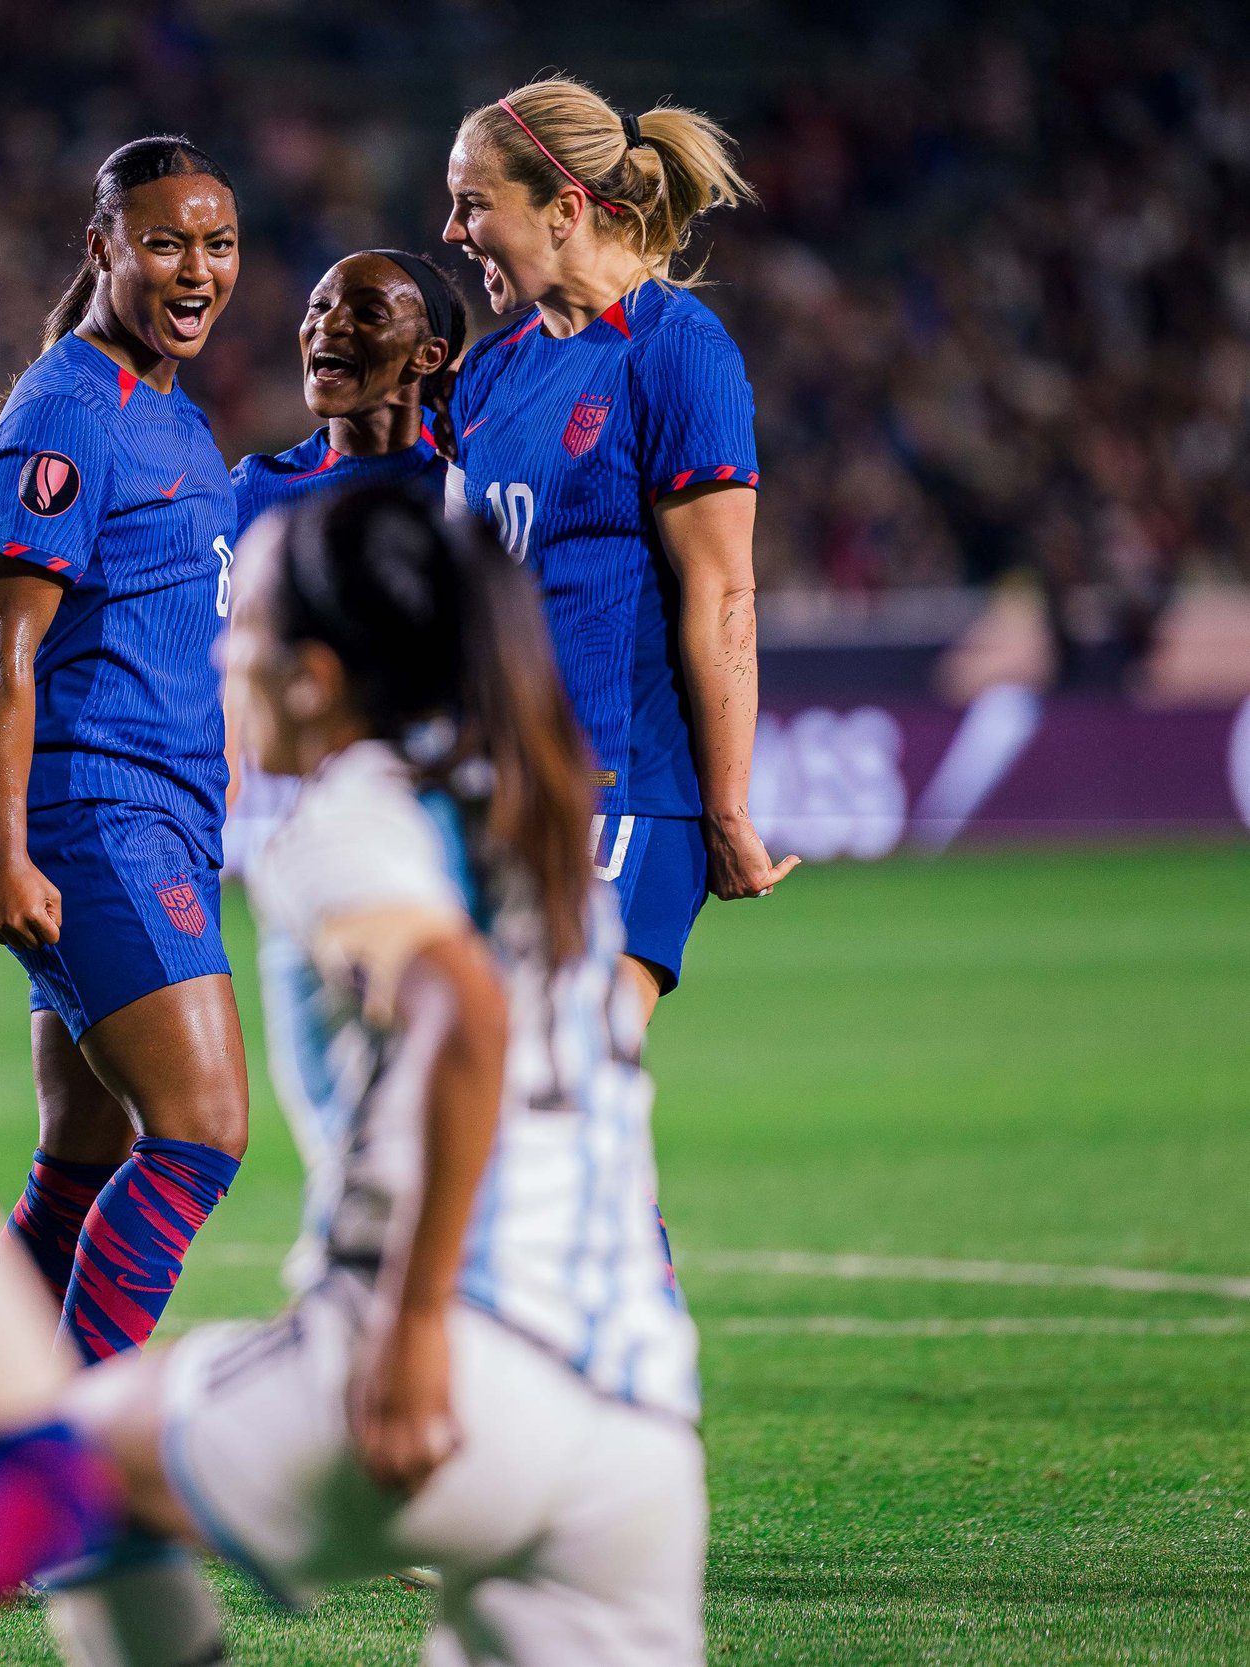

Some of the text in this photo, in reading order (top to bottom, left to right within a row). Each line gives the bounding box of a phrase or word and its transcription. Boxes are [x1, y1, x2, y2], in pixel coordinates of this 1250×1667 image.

[573, 405, 606, 428] USA
[486, 482, 534, 566] 10
[161, 887, 195, 909] USA
